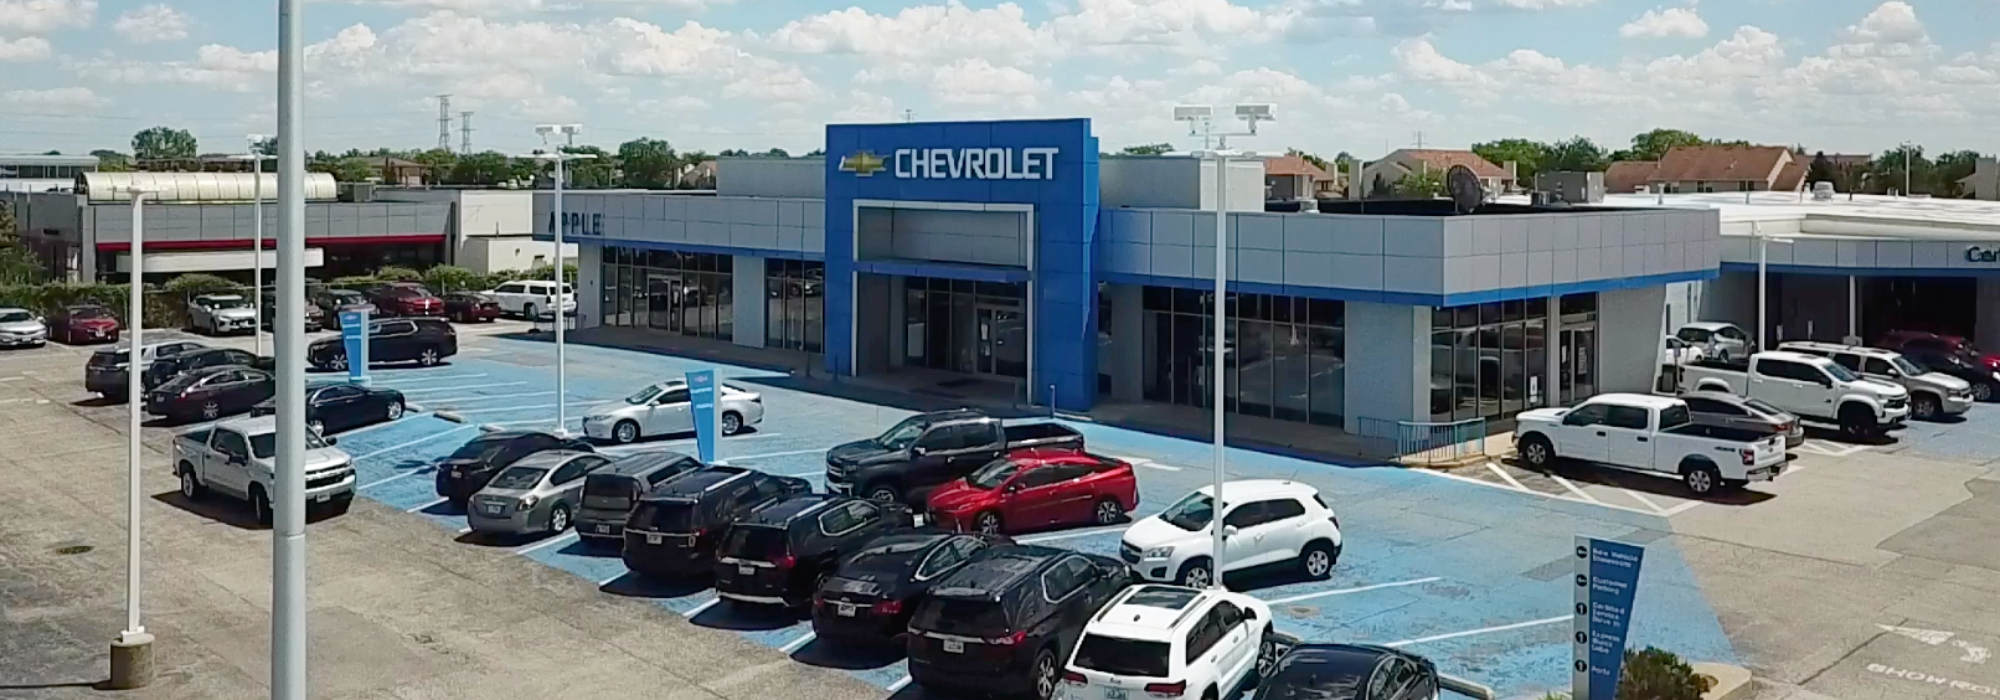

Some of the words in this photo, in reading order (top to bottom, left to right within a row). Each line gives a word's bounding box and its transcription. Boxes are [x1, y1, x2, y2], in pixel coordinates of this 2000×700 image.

[895, 147, 1059, 180] CHEVROLET
[548, 211, 602, 236] APPLE
[1966, 246, 2000, 263] Cer
[1867, 663, 1998, 696] SHOWRO
